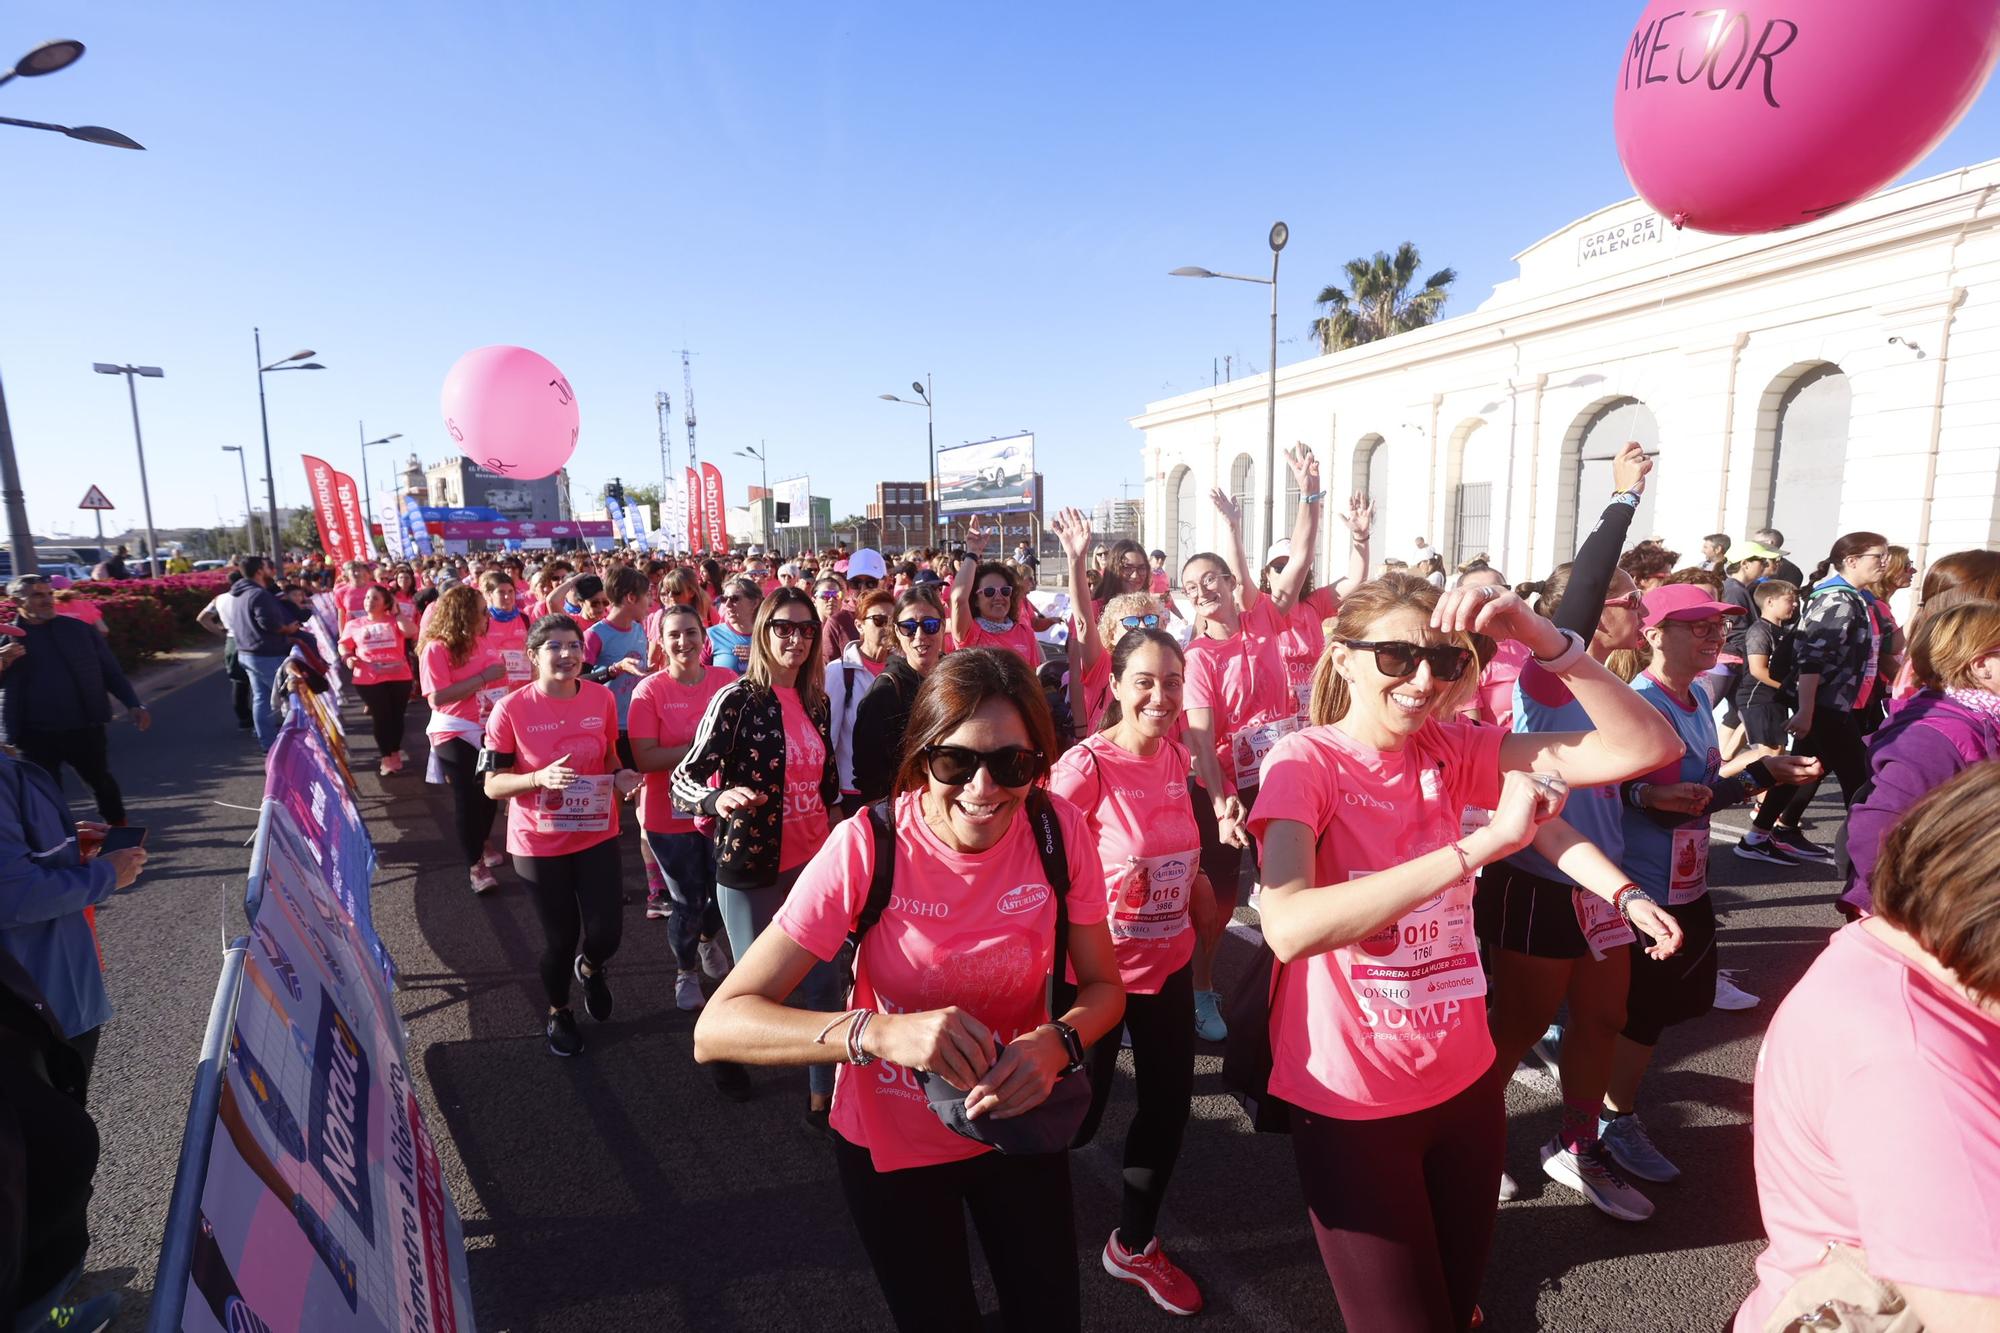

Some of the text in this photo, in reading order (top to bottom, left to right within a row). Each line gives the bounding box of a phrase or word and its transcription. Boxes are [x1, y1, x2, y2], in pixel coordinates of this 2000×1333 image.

[1625, 9, 1798, 108] MEJOR
[1586, 217, 1655, 248] GRAO DE
[1583, 230, 1656, 260] VALENCIA
[527, 723, 558, 733] OYSHO
[1256, 748, 1270, 758] 01
[565, 797, 590, 807] 016
[1002, 891, 1047, 910] ASTURIANA
[1153, 886, 1180, 902] 016
[888, 895, 949, 918] OYSHO
[1156, 902, 1173, 911] 3986
[1404, 920, 1439, 945] 016
[1413, 946, 1433, 961] 1760
[1367, 968, 1410, 978] CARRERA
[1412, 970, 1420, 978] DE
[1429, 963, 1450, 972] MUJER
[1450, 957, 1468, 967] 2023
[1363, 987, 1411, 999] OYSHO
[1436, 976, 1475, 991] Santander
[875, 1087, 911, 1100] CARRERA
[322, 1011, 359, 1213] Norauto
[399, 1181, 416, 1208] a
[400, 1207, 429, 1333] ómetro
